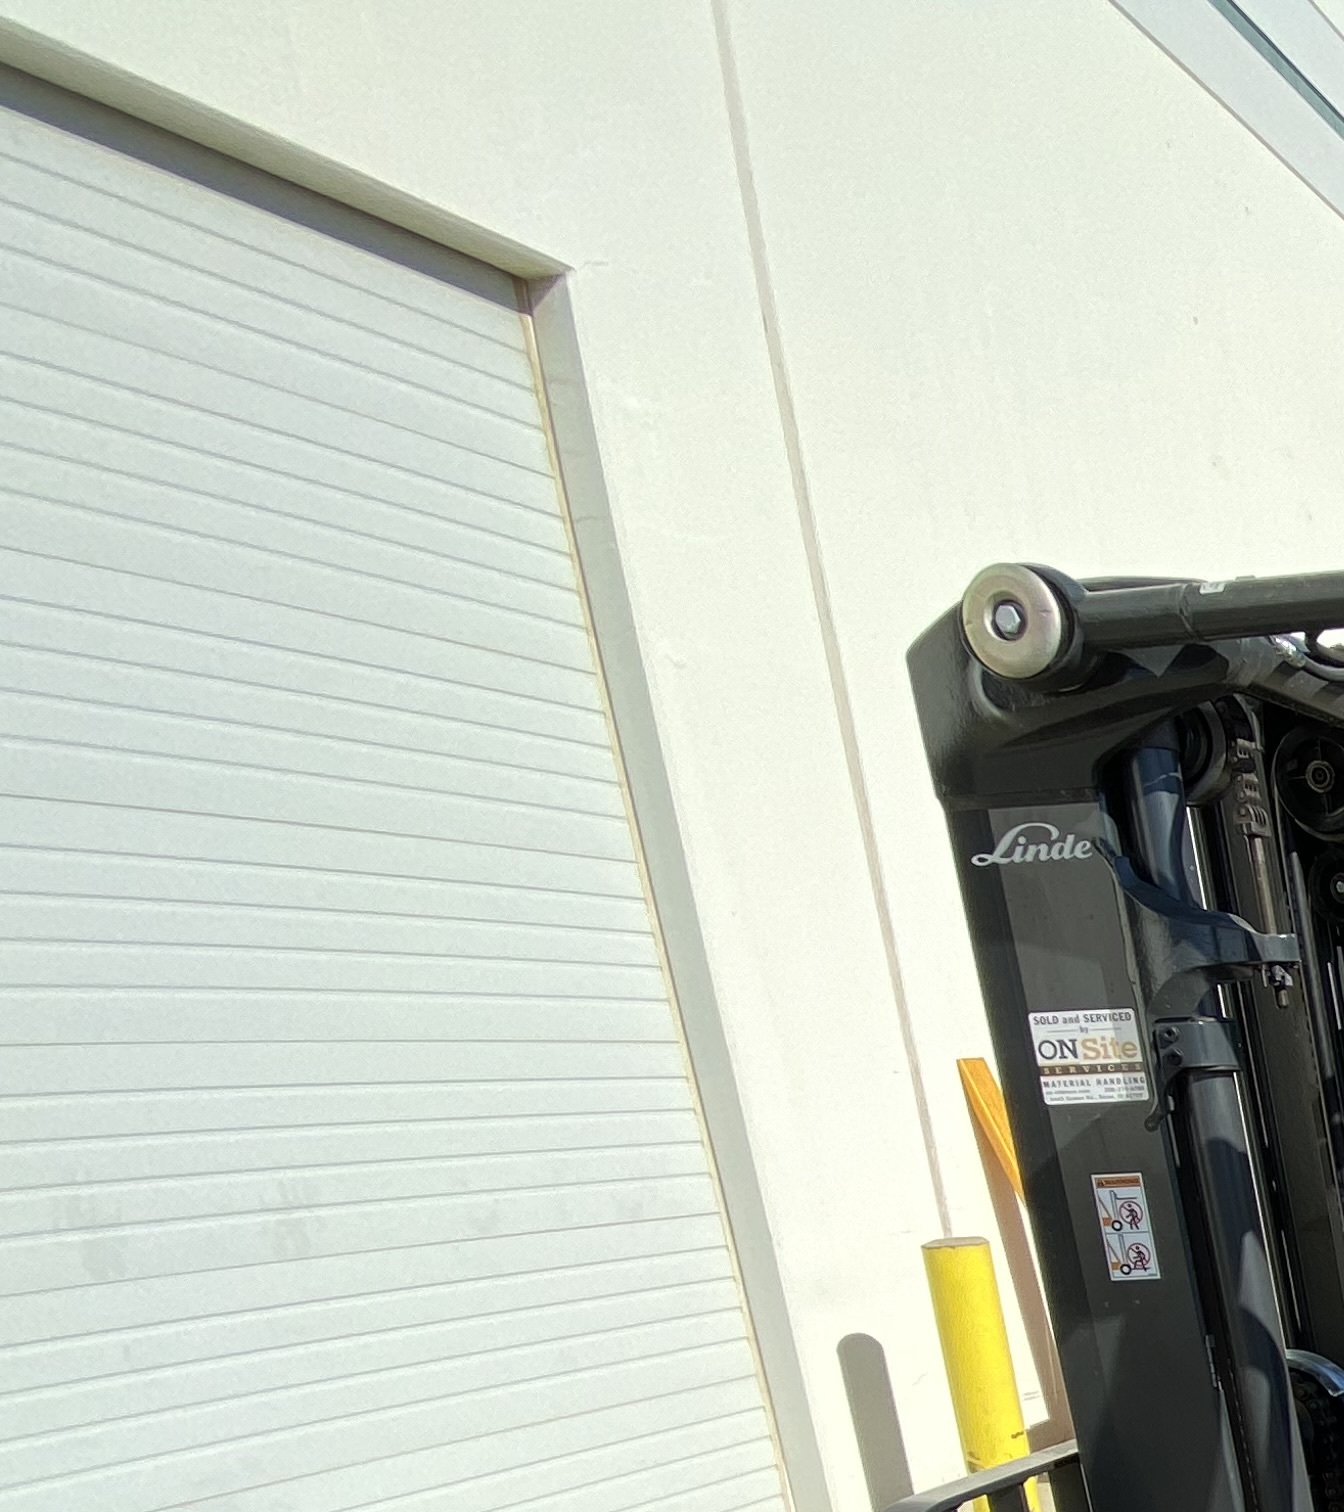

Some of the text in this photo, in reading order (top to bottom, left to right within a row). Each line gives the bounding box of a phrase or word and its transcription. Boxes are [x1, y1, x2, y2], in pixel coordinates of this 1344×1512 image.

[971, 822, 1093, 867] Linde
[1033, 1011, 1132, 1026] SOLD and SERVICED
[1043, 1063, 1142, 1075] SERVICES
[1043, 1076, 1145, 1088] MATERIAL HANDLING
